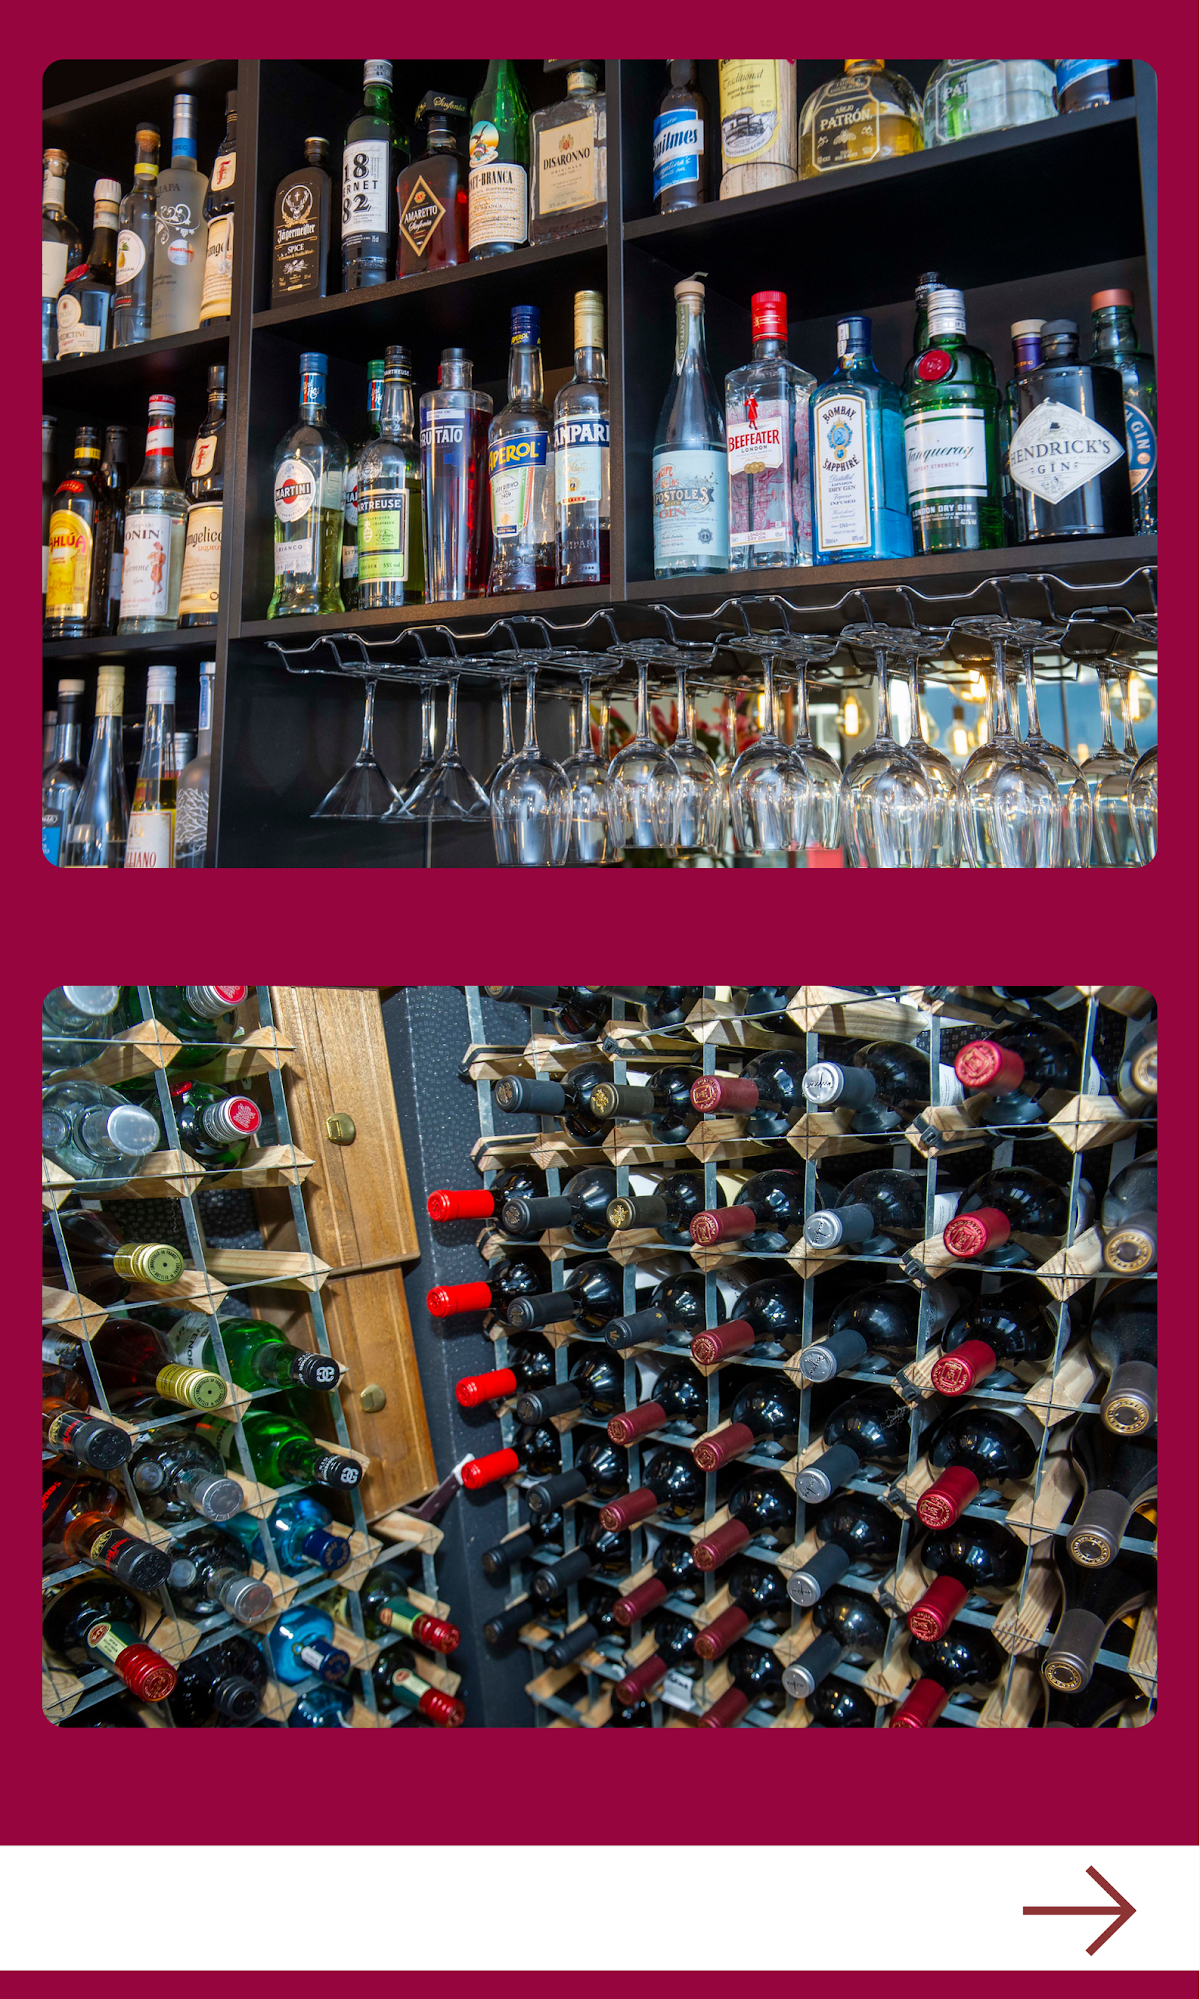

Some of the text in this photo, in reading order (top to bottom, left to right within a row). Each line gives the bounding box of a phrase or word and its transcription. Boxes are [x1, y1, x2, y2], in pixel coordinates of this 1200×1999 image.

[433, 97, 466, 112] Sinfonia
[820, 108, 871, 131] PATRÓN
[543, 147, 590, 170] DISARONNO
[343, 194, 371, 224] 82
[404, 205, 438, 223] AMARETTO
[287, 243, 304, 254] SPICE
[822, 406, 856, 424] BOMBAY
[728, 429, 780, 453] BEEFEATER
[1130, 421, 1151, 450] GIN
[489, 441, 539, 471] APEROL
[741, 445, 768, 453] LONDON
[908, 446, 975, 466] Tanqueray
[1010, 440, 1111, 467] HENDRICK'S
[822, 454, 860, 472] SAPPHIRE
[1037, 462, 1071, 475] GIN
[276, 483, 311, 500] MARTINI
[660, 507, 687, 519] GIN
[912, 503, 973, 518] LONDON DRY GIN
